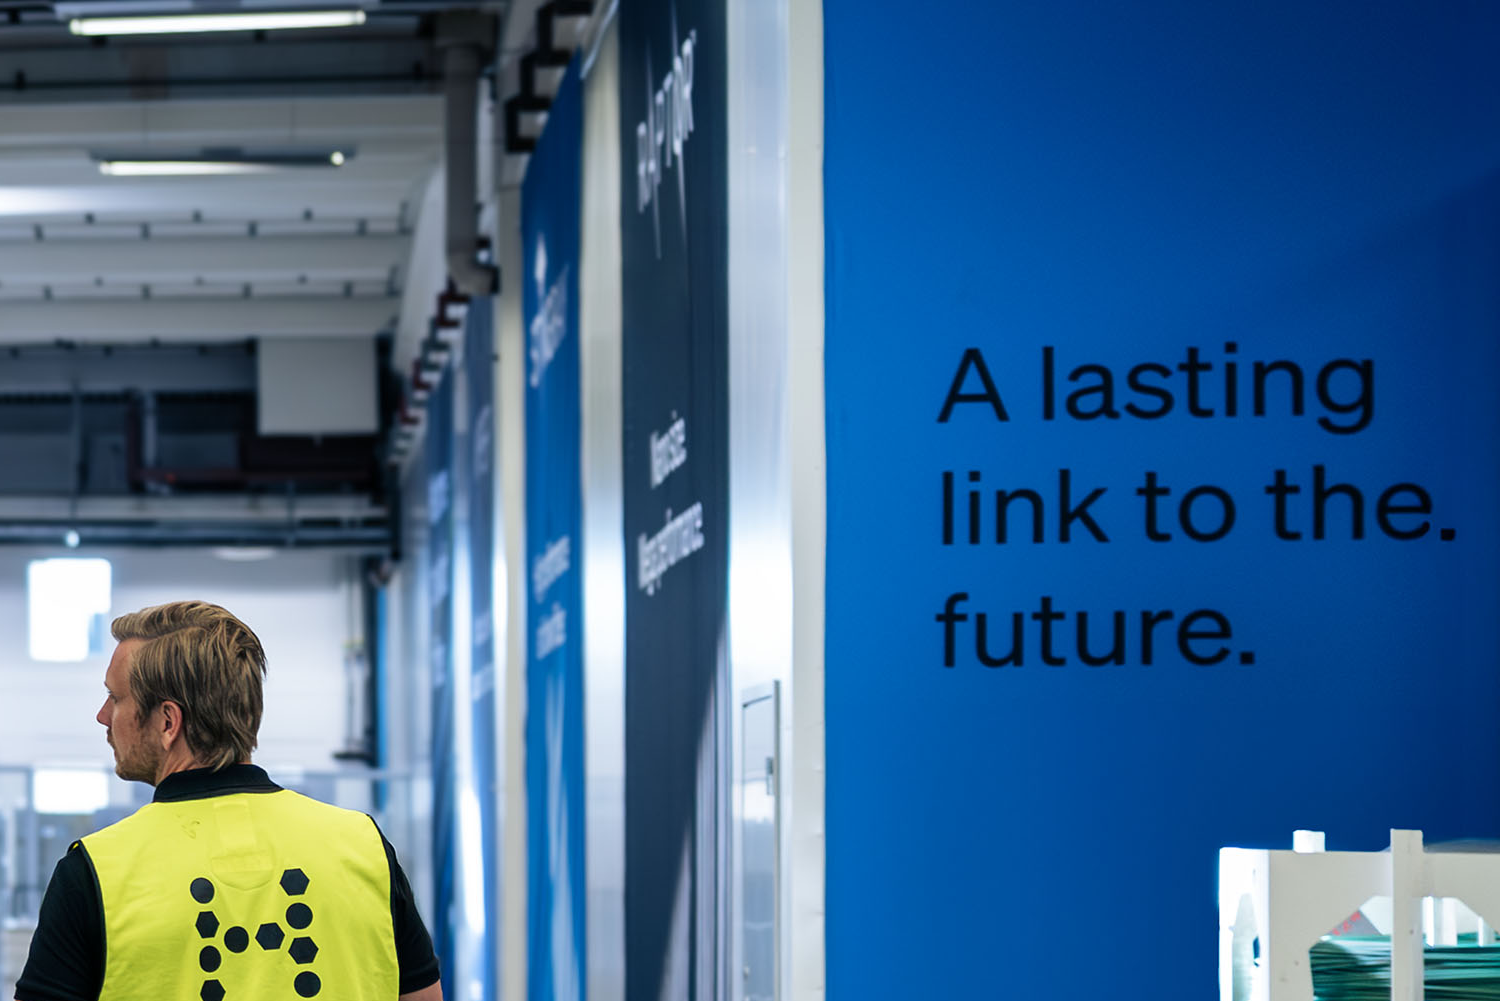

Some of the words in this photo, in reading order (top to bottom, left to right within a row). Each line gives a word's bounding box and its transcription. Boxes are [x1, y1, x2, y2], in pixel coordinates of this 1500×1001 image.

[936, 348, 1009, 423] A
[1042, 341, 1375, 435] lasting
[942, 468, 1110, 545] link
[1135, 471, 1237, 543] to
[1264, 464, 1457, 541] the.
[935, 592, 1256, 668] future.
